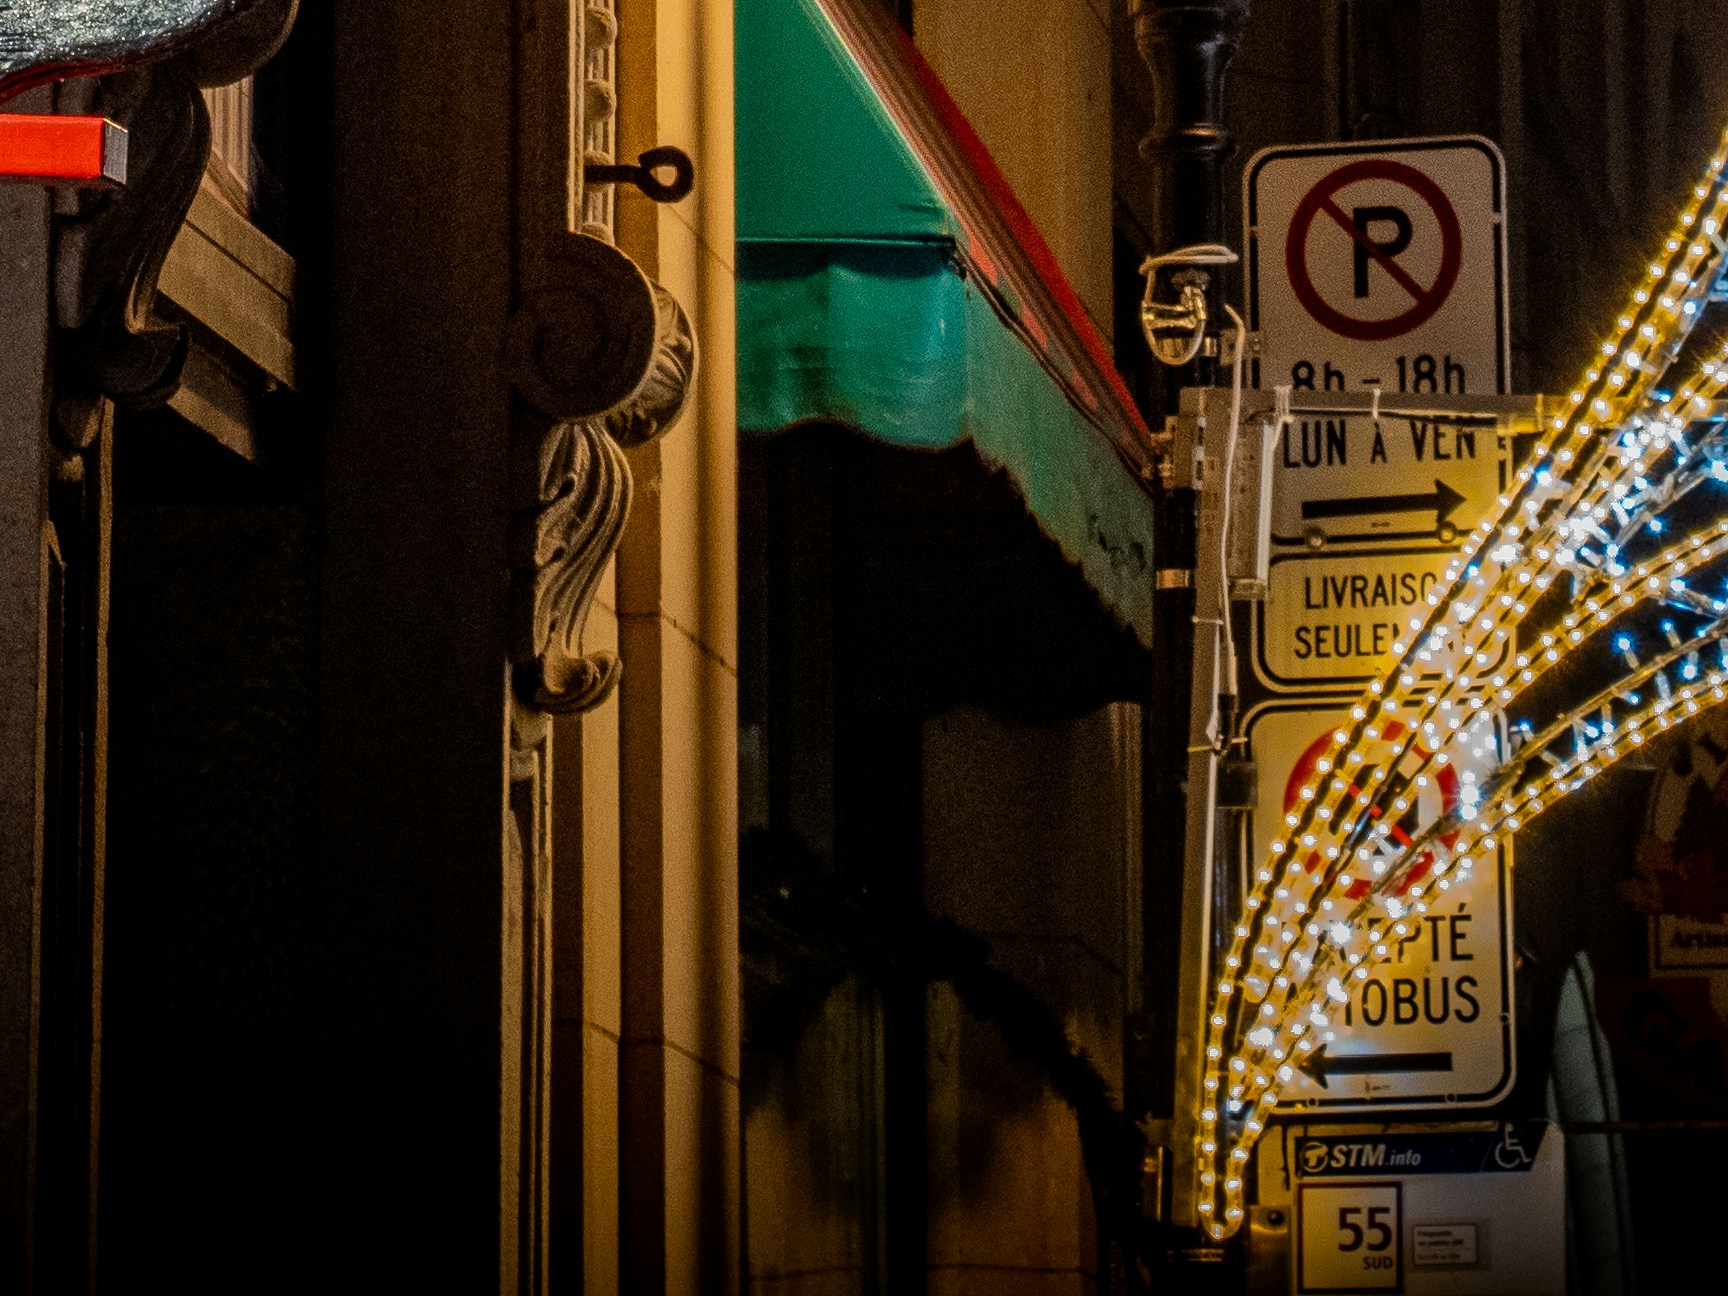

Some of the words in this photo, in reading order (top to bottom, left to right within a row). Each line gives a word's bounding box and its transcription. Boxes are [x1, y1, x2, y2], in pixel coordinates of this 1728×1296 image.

[1291, 359, 1346, 392] 8h
[1394, 353, 1466, 395] 18h
[1282, 419, 1347, 469] LUN
[1408, 416, 1477, 462] VEN
[1338, 1207, 1392, 1252] 55
[1362, 1256, 1394, 1271] SUD
